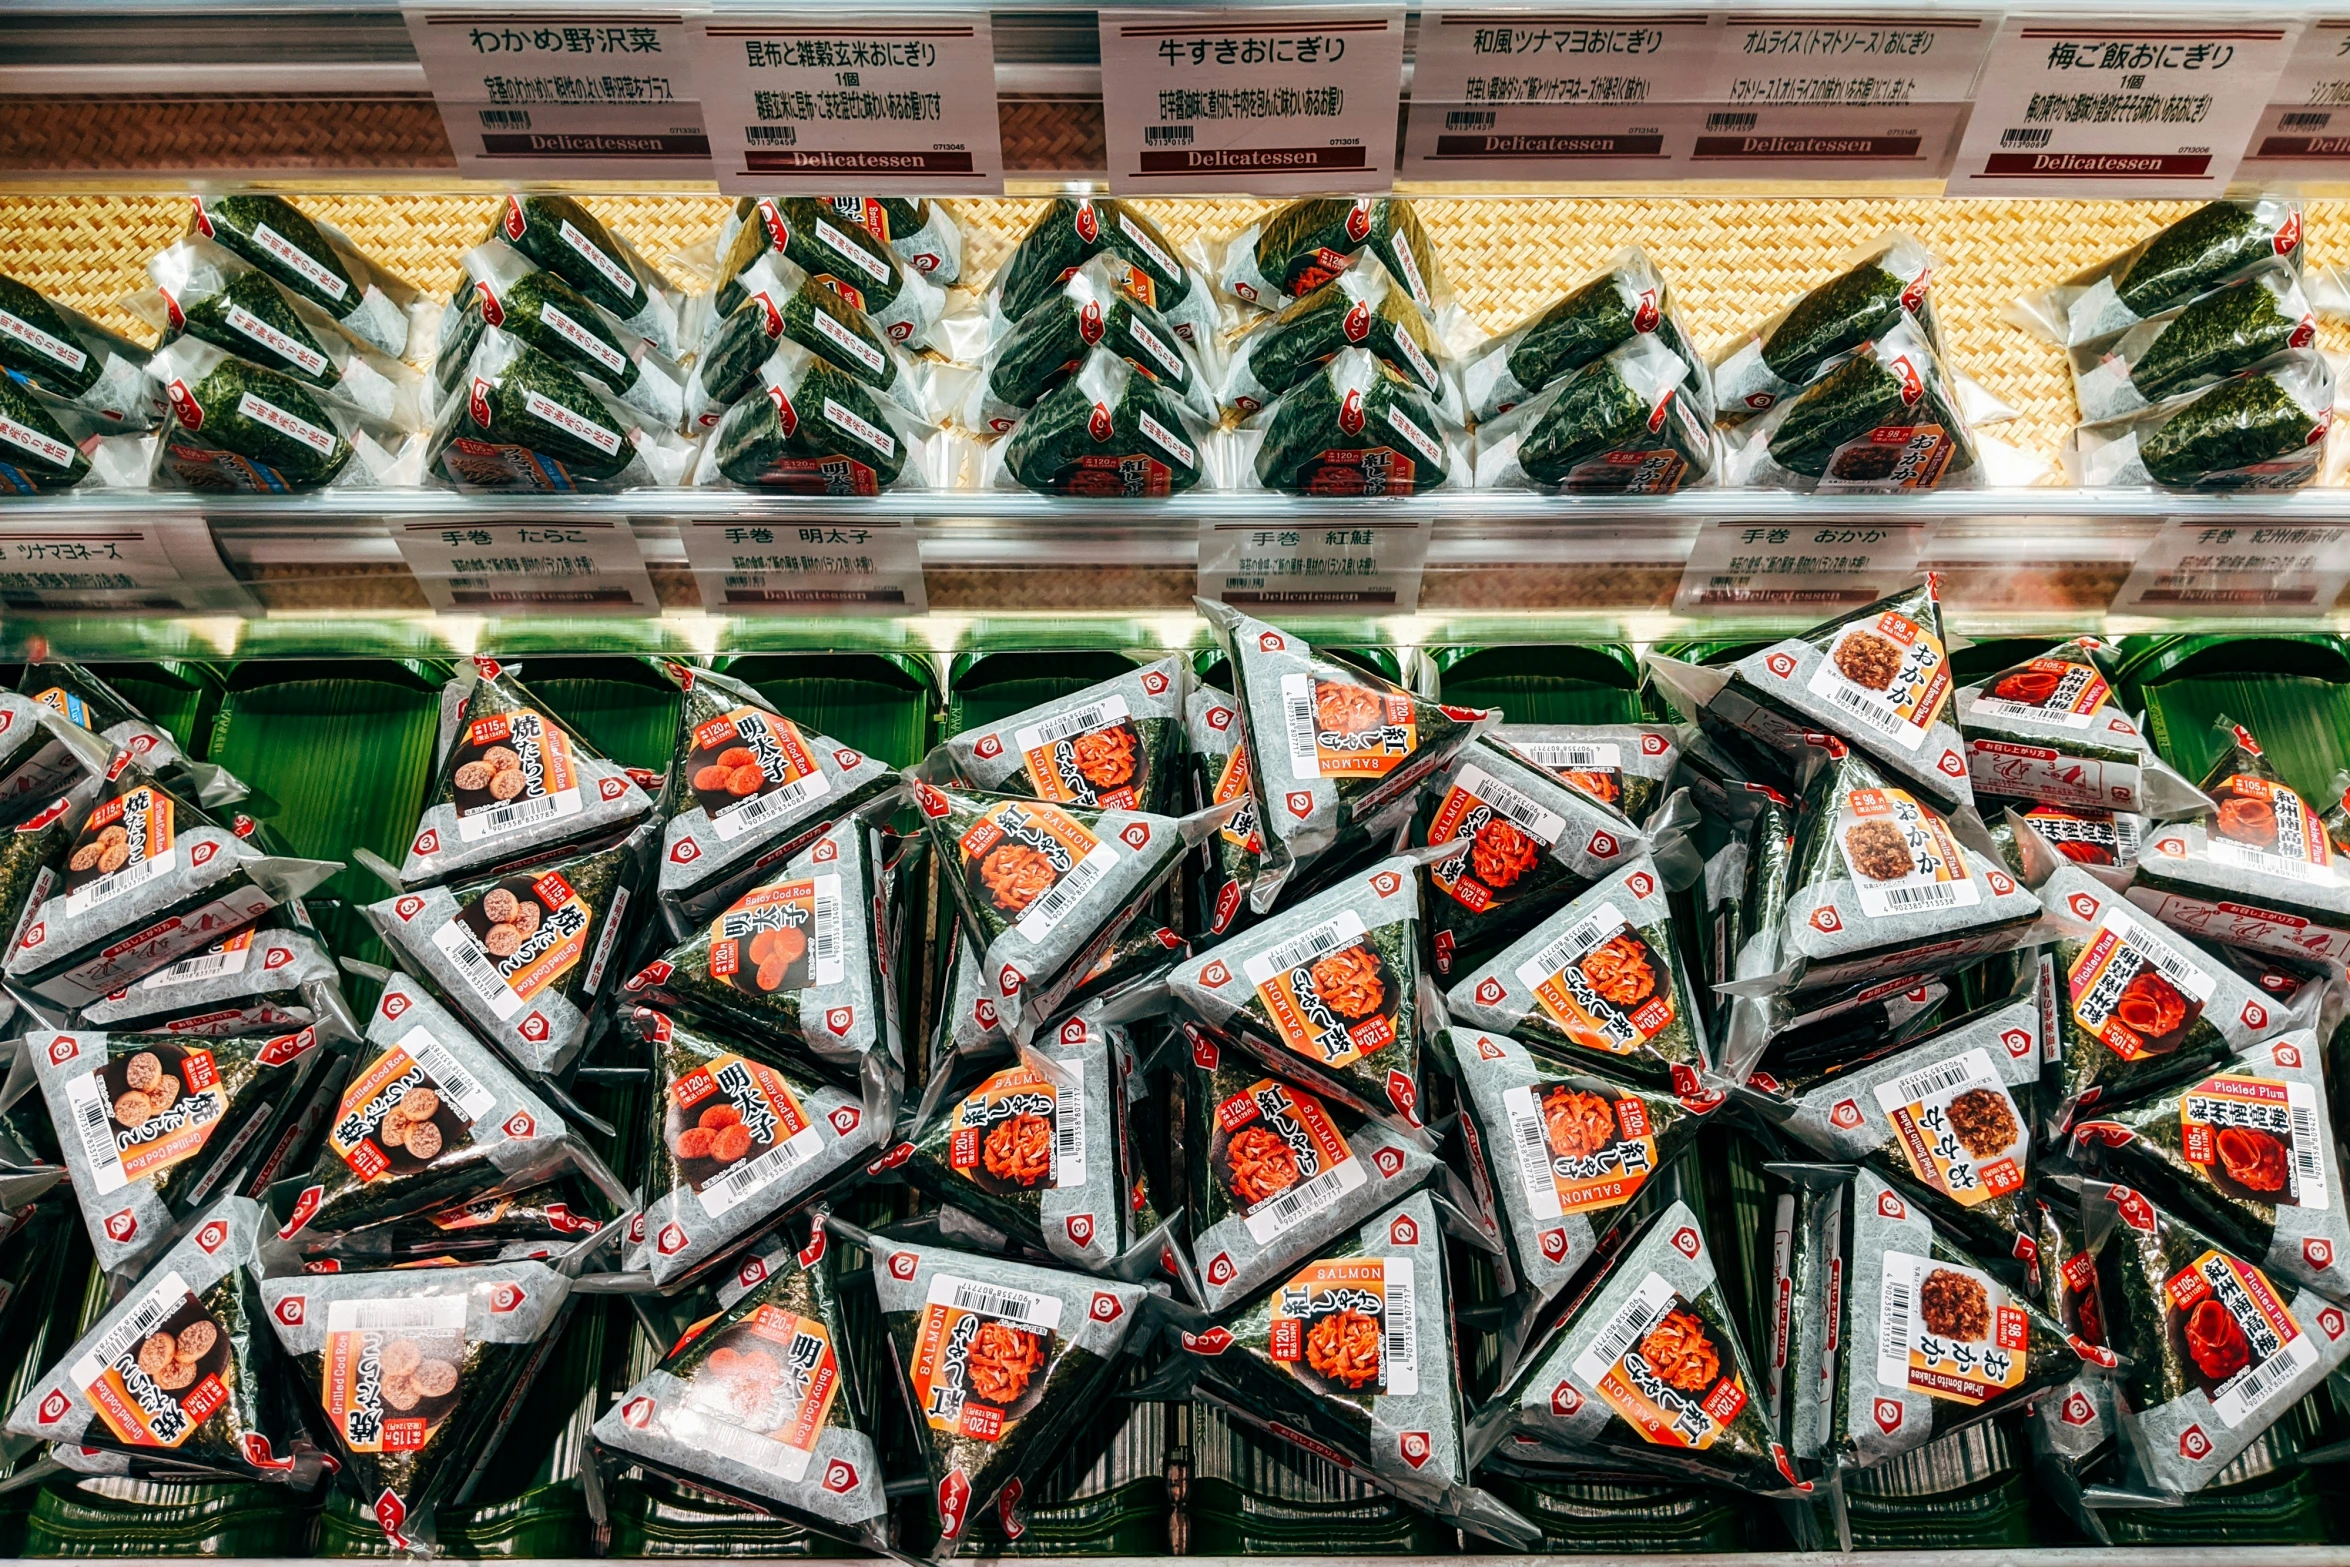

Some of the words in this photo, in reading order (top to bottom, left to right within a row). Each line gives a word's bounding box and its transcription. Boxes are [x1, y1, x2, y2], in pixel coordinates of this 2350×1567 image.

[469, 28, 662, 53] わかめ野沢菜
[746, 40, 935, 67] 昆布と雑穀玄米おにぎり
[1159, 36, 1344, 66] 牛すきおにぎり
[1473, 29, 1663, 54] 和風ツナマヨおにぎり
[2048, 42, 2234, 70] 梅ご飯おにぎり
[835, 73, 860, 86] 1個
[2120, 75, 2145, 89] 1個
[530, 135, 663, 150] Delicatessen
[1485, 137, 1615, 150] Delicatessen
[1742, 138, 1872, 152] Delicatessen
[792, 152, 926, 167] Delicatessen
[1188, 151, 1318, 166] Delicatessen
[2032, 156, 2162, 171] Delicatessen
[259, 231, 341, 293] 有明海産のり使用
[232, 311, 322, 370] 有明海産のり使用
[546, 308, 621, 369] 有明海産のり使用
[245, 399, 331, 449] 有明海産のり使用
[533, 398, 616, 449] 有明海産のり使用
[1893, 434, 1936, 481] おかか
[442, 530, 492, 547] 手巻
[518, 529, 587, 543] たらこ
[725, 528, 774, 544] 手巻
[799, 528, 873, 544] 明太子
[1253, 532, 1300, 547] 手巻
[1325, 530, 1374, 545] 紅鮭
[1741, 529, 1790, 544] 手巻
[1814, 529, 1887, 544] おかか
[2198, 529, 2236, 544] 手巻
[17, 543, 123, 560] ツナマヨネーズ
[1888, 641, 1939, 706] おかか
[2046, 667, 2092, 711] 紀州南高梅
[548, 731, 560, 757] Grilled
[736, 712, 788, 784] 明太子
[775, 722, 790, 743] Spicy
[787, 743, 800, 758] Cod
[795, 757, 808, 774] Roe
[1318, 726, 1409, 754] 紅しゃけ
[1984, 742, 2047, 758] お召し上がり方
[511, 716, 546, 797] 焼たらこ
[554, 757, 563, 772] Cod
[1322, 758, 1379, 769] SALMON
[557, 773, 565, 789] Roe
[155, 800, 164, 823] Grilled
[1433, 789, 1467, 842] SALMON
[2273, 787, 2306, 859] 紀州南高梅
[123, 791, 150, 865] 焼たらこ
[156, 824, 164, 837] Cod
[492, 822, 524, 832] 907358
[994, 803, 1072, 872] 紅しゃけ
[1043, 811, 1093, 852] SALMON
[1894, 801, 1941, 875] おかか
[156, 838, 164, 853] Roe
[1928, 817, 1940, 836] Dried
[1937, 836, 1951, 856] Bonito
[1945, 856, 1960, 878] Flakes
[745, 895, 771, 906] Spicy
[772, 890, 791, 899] Cod
[793, 888, 811, 896] Roe
[723, 901, 808, 939] 明太子
[2230, 905, 2296, 925] お召し上がり方
[499, 904, 583, 979] 焼たらこ
[589, 895, 627, 986] 有明海産のり使用
[550, 943, 578, 969] Grilled
[2074, 954, 2102, 986] Pickled
[2096, 934, 2115, 954] Plum
[517, 978, 536, 992] Roe
[533, 964, 550, 980] Cod
[2078, 945, 2143, 1027] 紀州南高梅
[1265, 981, 1303, 1039] SALMON
[1290, 968, 1354, 1062] 紅しゃけ
[1541, 984, 1588, 1033] SALMON
[1562, 965, 1634, 1049] 紅しゃけ
[345, 1080, 373, 1108] Grilled
[372, 1066, 389, 1081] Cod
[388, 1053, 405, 1069] Roe
[2214, 1081, 2255, 1096] Pickled
[2259, 1087, 2285, 1099] Plum
[334, 1067, 424, 1148] 焼たらこ
[715, 1062, 777, 1143] 明太子
[759, 1070, 778, 1096] Spicy
[774, 1092, 790, 1115] Cod
[784, 1110, 798, 1132] Roe
[961, 1092, 1054, 1126] 紅しゃけ
[2187, 1096, 2291, 1134] 紀州南高梅
[117, 1092, 222, 1152] 焼たらこ
[1256, 1083, 1319, 1177] 紅しゃけ
[1303, 1104, 1344, 1162] SALMON
[1899, 1110, 1911, 1134] Flakes
[148, 1148, 166, 1161] Cod
[166, 1133, 202, 1153] Grilled
[1910, 1129, 1925, 1157] Bonito
[1919, 1105, 1977, 1189] おかか
[127, 1158, 147, 1169] Roe
[1554, 1140, 1651, 1178] 紅しゃけ
[1920, 1156, 1937, 1179] Dried
[1561, 1183, 1622, 1204] SALMON
[1317, 1268, 1381, 1279] SALMON
[1280, 1284, 1382, 1318] 紅しゃけ
[1830, 1271, 1838, 1339] お召し上がり方
[2203, 1257, 2281, 1358] 紀州南高梅
[2244, 1271, 2275, 1311] Pickled
[2272, 1311, 2292, 1339] Plum
[1781, 1289, 1789, 1356] お召し上がり方
[336, 1335, 348, 1354] Roe
[920, 1308, 945, 1376] SALMON
[1406, 1324, 1414, 1360] 907358
[334, 1355, 345, 1376] Cod
[928, 1314, 977, 1422] 紅しゃけ
[1920, 1335, 2010, 1382] おかか
[96, 1380, 111, 1398] Roe
[349, 1333, 383, 1443] 焼たらこ
[814, 1368, 832, 1399] Spicy
[1911, 1369, 1936, 1386] Flakes
[1937, 1375, 1963, 1392] Bonito
[1966, 1381, 1984, 1397] Dried
[108, 1396, 120, 1413] Cod
[114, 1353, 187, 1442] 焼たらこ
[332, 1379, 344, 1414] Grilled
[1603, 1378, 1658, 1431] SALMON
[1623, 1353, 1710, 1447] 紅しゃけ
[117, 1411, 144, 1440] Grilled
[803, 1401, 820, 1423] Cod
[795, 1421, 811, 1444] Roe
